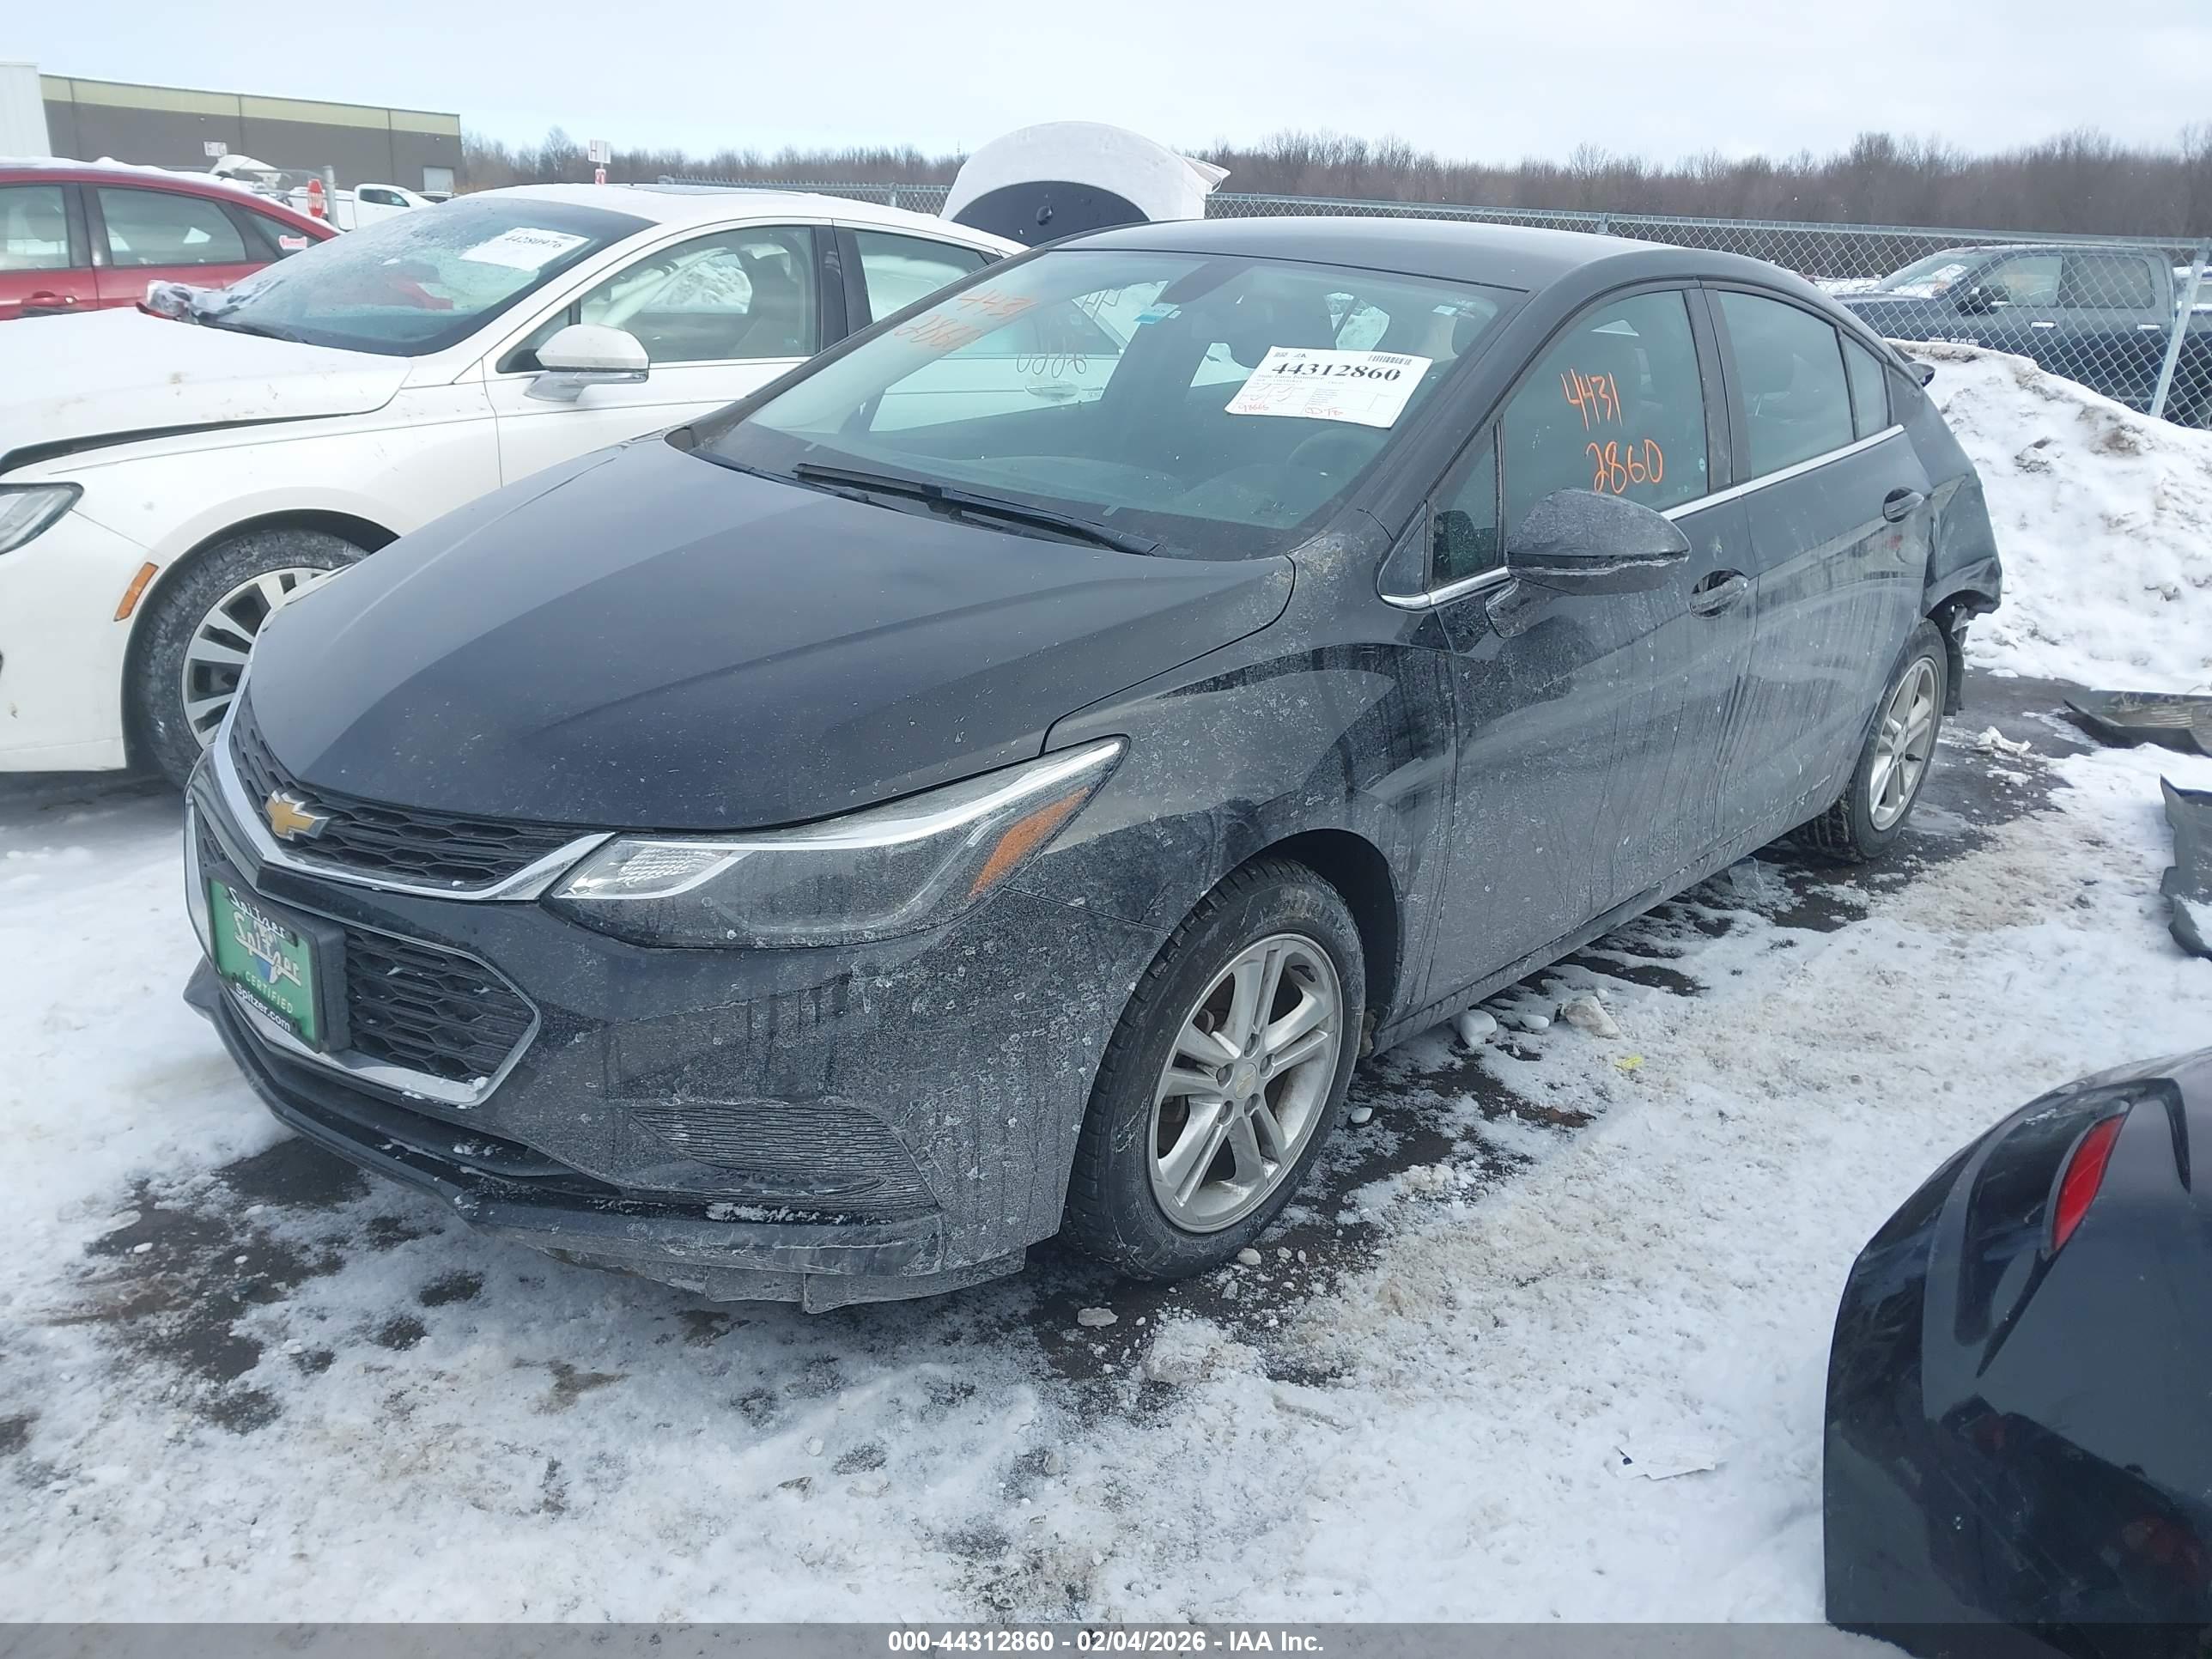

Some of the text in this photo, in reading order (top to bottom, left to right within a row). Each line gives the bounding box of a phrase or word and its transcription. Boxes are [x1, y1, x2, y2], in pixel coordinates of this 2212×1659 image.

[1272, 362, 1401, 381] 44312860
[1560, 368, 1623, 432] 4431
[1584, 439, 1663, 495] 2860
[228, 886, 286, 939] Spitzer
[234, 981, 291, 1032] Spitzer.com
[245, 970, 294, 1015] CERTIFIED
